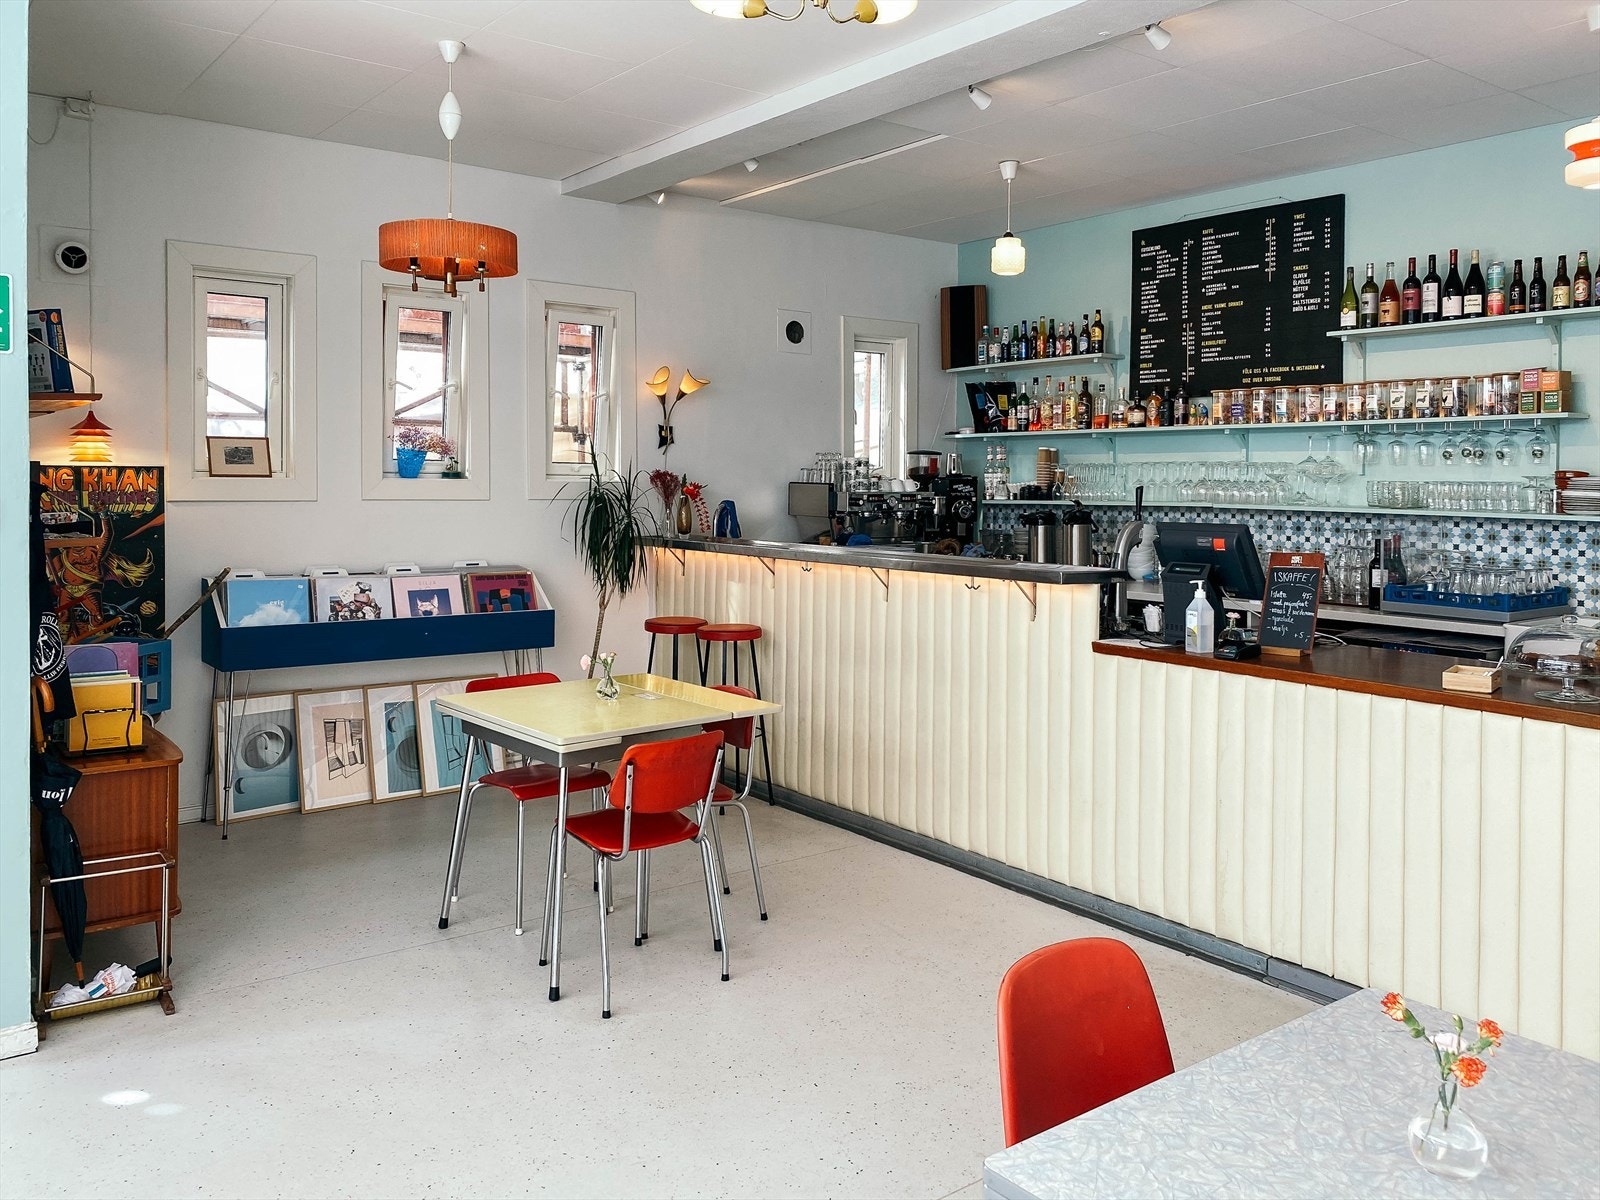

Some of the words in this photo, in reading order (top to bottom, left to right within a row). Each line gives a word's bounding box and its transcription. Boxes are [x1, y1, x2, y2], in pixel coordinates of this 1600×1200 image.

[1228, 300, 1244, 308] DRIKKER
[1292, 297, 1321, 305] SALTSTENGER
[81, 467, 159, 493] KHAN
